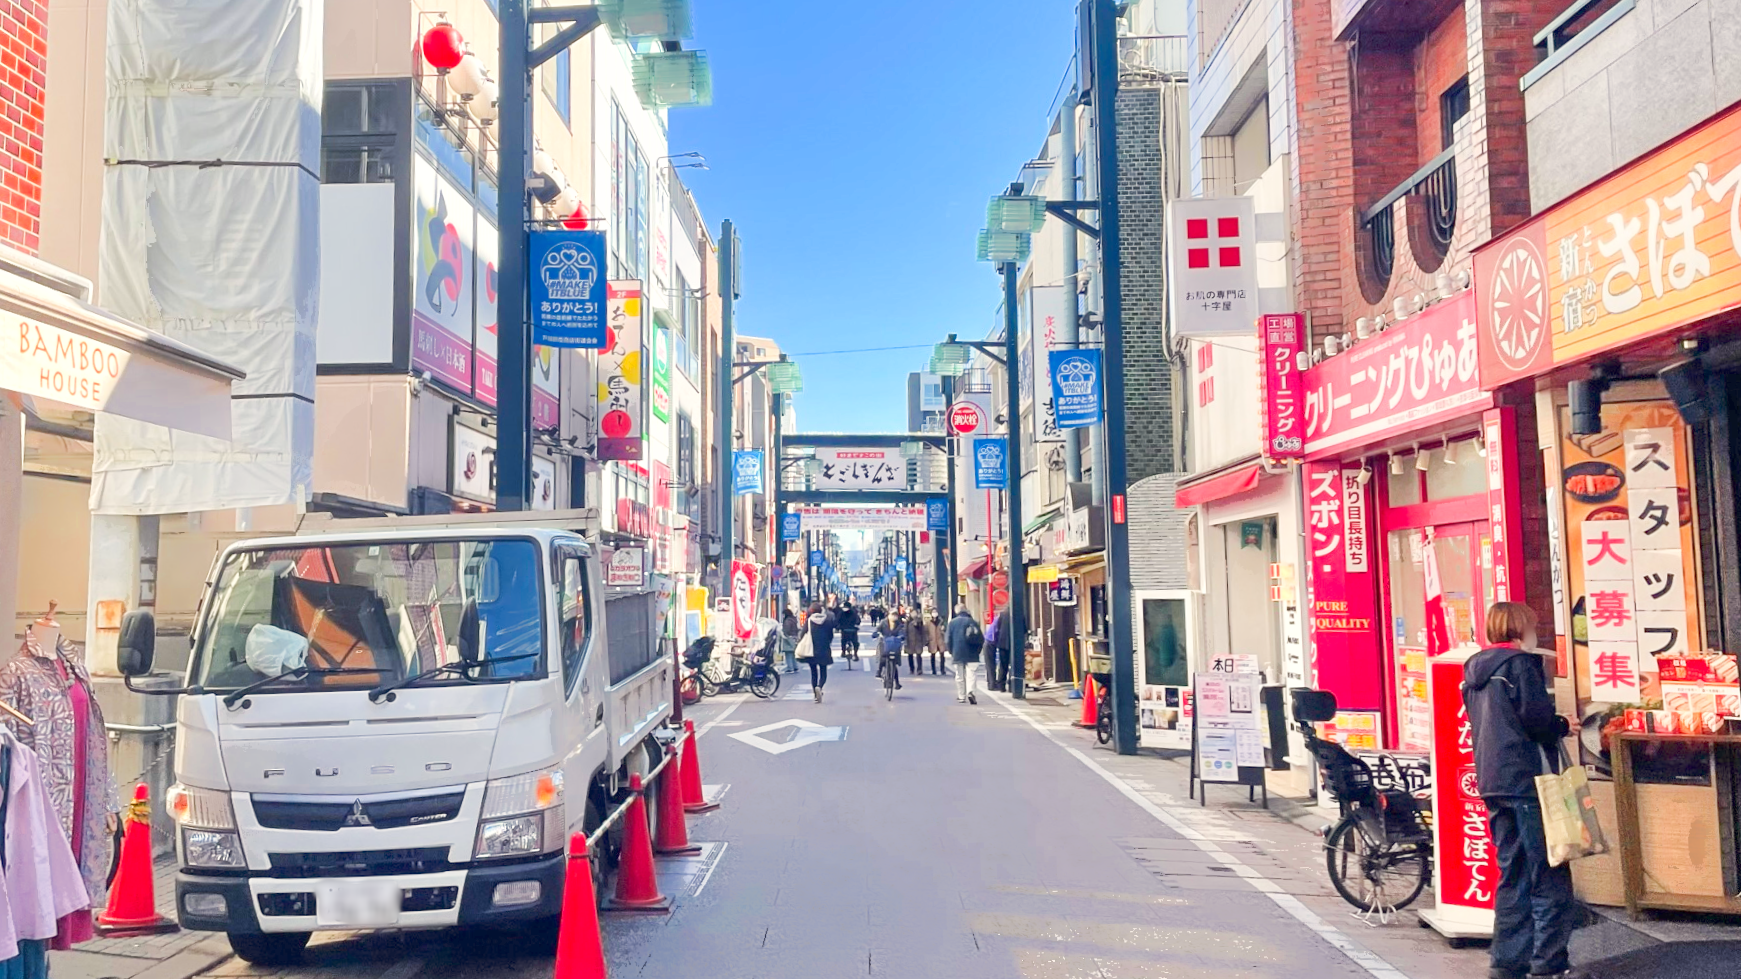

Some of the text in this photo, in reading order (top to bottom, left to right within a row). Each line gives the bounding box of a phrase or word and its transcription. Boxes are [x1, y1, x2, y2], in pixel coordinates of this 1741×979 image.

[549, 280, 588, 289] #MAKE
[1559, 233, 1583, 335] 新宿
[1582, 225, 1598, 326] とんかつ
[541, 301, 598, 313] ありがとう!
[1186, 290, 1247, 300] お肌の専門店
[1201, 301, 1232, 311] 十字屋
[19, 322, 119, 378] BAMBOO
[40, 367, 100, 402] HOUSE
[1275, 347, 1296, 432] クリーニング
[1305, 318, 1478, 438] クリーニングぴゅあ
[1058, 394, 1097, 405] ありがとう!
[954, 414, 977, 425] 消火栓
[1345, 475, 1363, 566] 折り目長持ち
[1631, 442, 1679, 657] スタッフ
[1316, 602, 1348, 612] PURE
[1586, 531, 1636, 689] 大募集
[1316, 618, 1371, 630] QUALITY
[1212, 658, 1234, 673] 本日
[264, 762, 452, 778] FUSO
[1463, 811, 1491, 902] さぼてん
